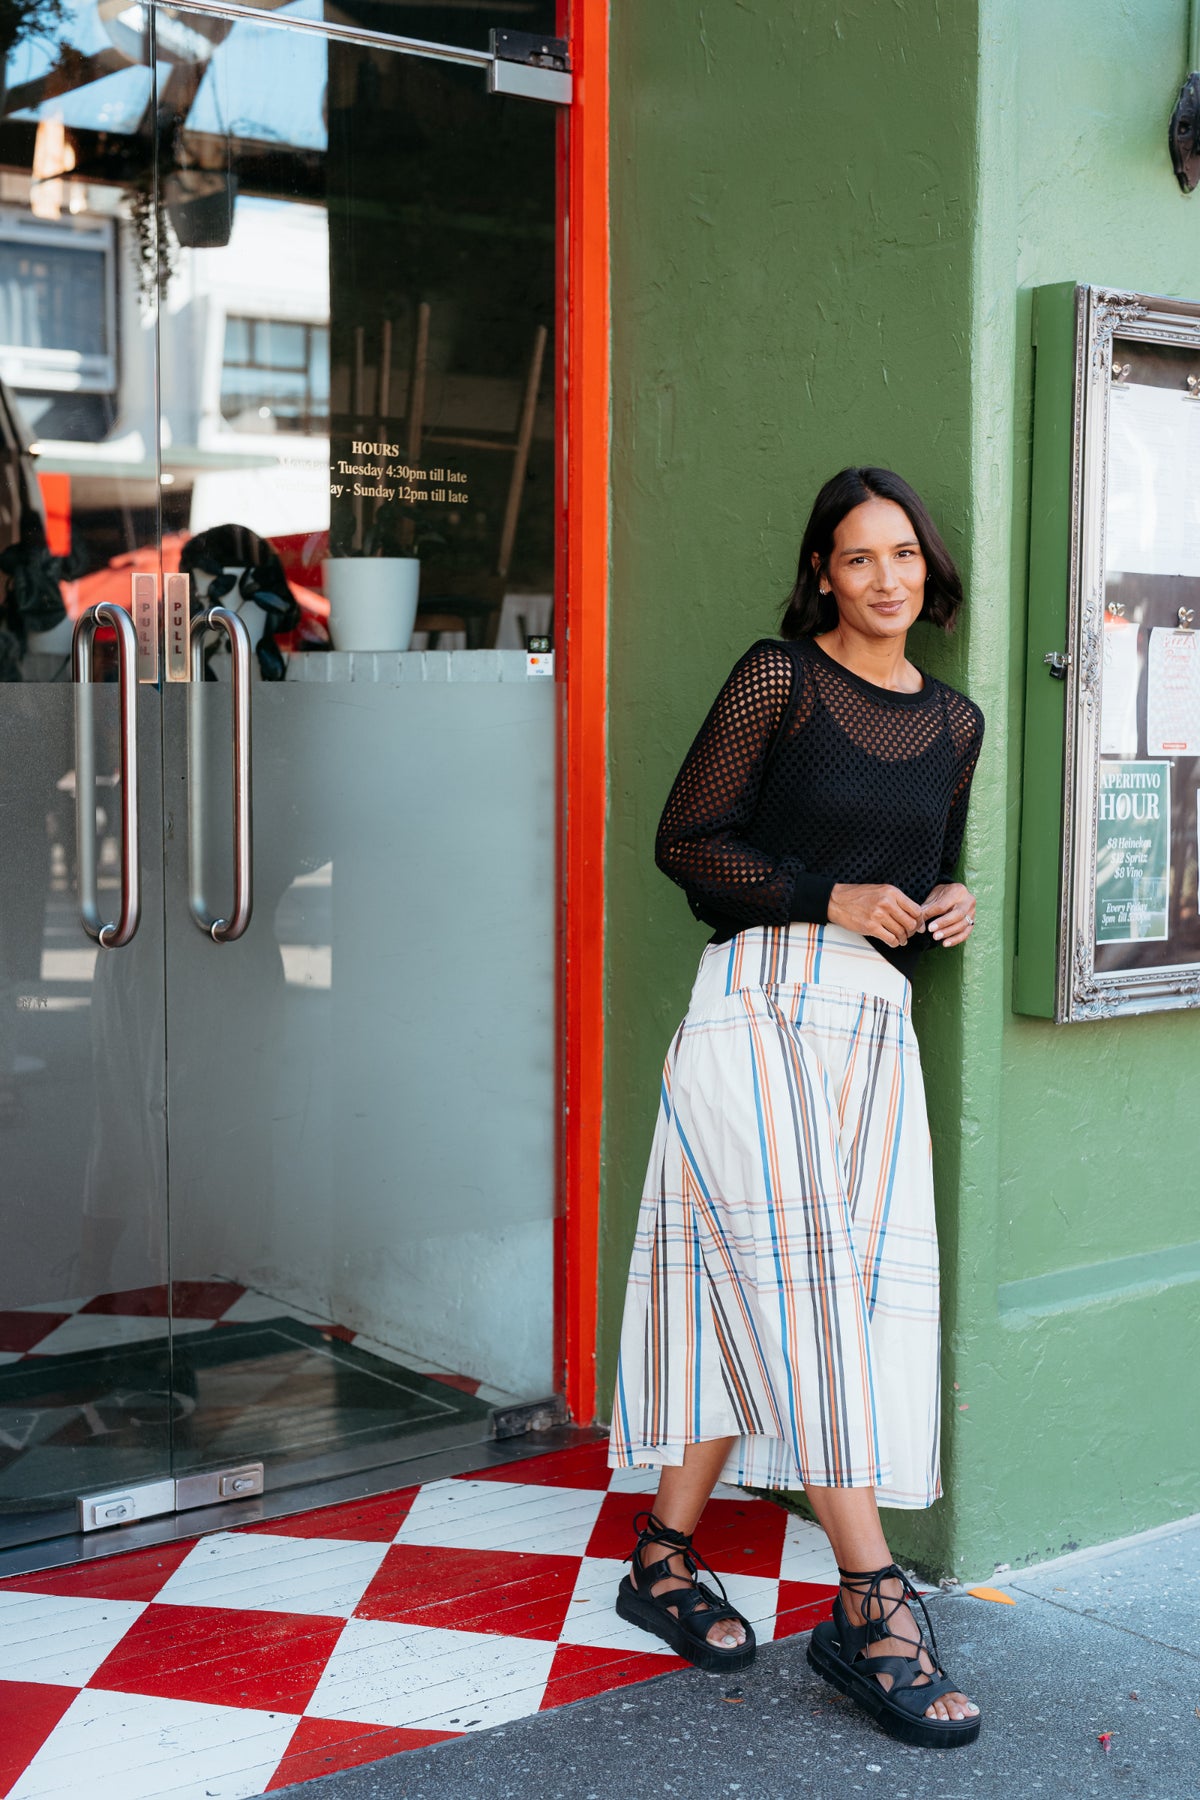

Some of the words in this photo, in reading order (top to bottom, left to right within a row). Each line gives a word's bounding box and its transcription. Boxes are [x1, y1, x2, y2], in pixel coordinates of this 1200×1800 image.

[351, 441, 400, 457] HOURS
[337, 460, 384, 479] Tuesday
[386, 464, 427, 482] 4:30pm
[429, 467, 444, 482] till
[447, 469, 468, 484] late
[353, 483, 396, 501] Sunday
[398, 486, 428, 503] 12pm
[431, 489, 446, 502] till
[448, 490, 469, 504] late
[174, 603, 182, 654] PULL
[1100, 772, 1161, 789] APERITIVO
[1099, 792, 1160, 821] HOUR
[1106, 837, 1118, 849] $8
[1118, 835, 1152, 849] Heineken
[1125, 852, 1148, 866] Spritz
[1126, 867, 1143, 878] Vino
